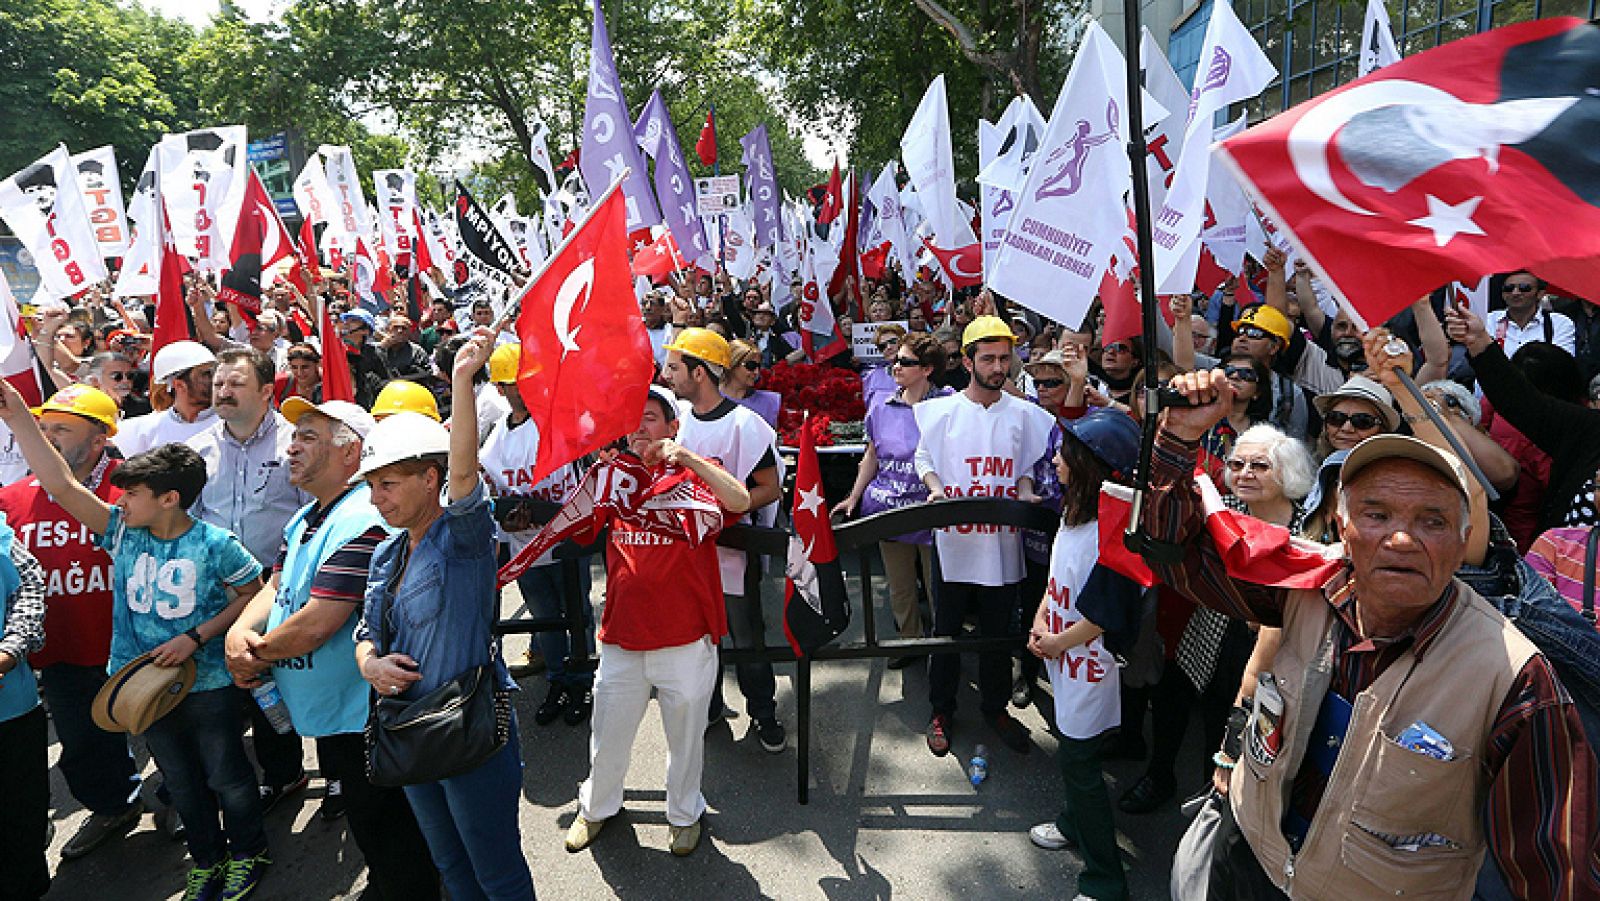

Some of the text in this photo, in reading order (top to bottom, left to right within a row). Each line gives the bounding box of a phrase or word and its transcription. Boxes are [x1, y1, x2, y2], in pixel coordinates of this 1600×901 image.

[1021, 217, 1093, 257] CUMHURİYET
[1051, 251, 1095, 280] DERNEĞİ
[965, 456, 1014, 478] TAM
